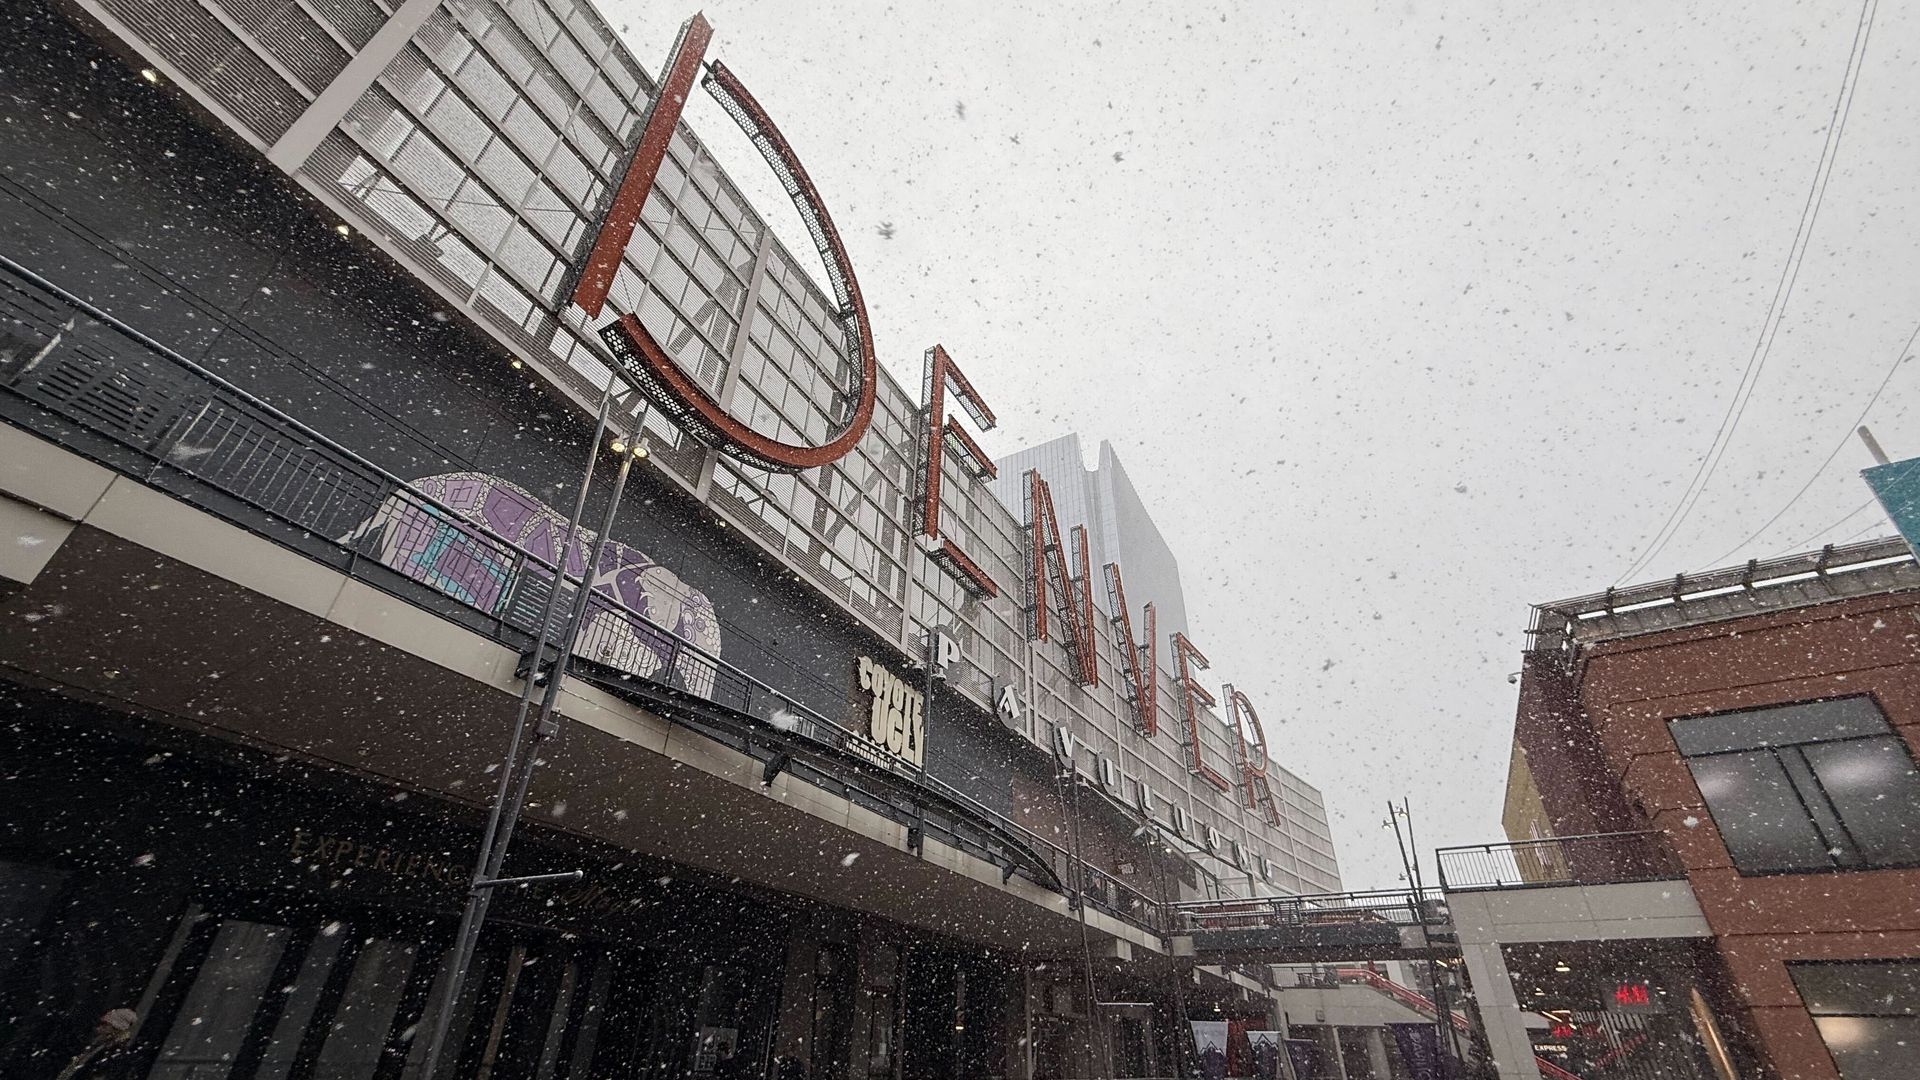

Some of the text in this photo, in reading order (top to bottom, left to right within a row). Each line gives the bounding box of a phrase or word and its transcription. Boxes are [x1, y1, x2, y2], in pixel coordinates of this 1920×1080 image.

[562, 10, 1281, 828] DENVER
[857, 655, 925, 716] COYOTE
[871, 695, 925, 768] UGLY
[288, 830, 475, 888] EXPERIENC
[1533, 1043, 1569, 1053] EXPRESS
